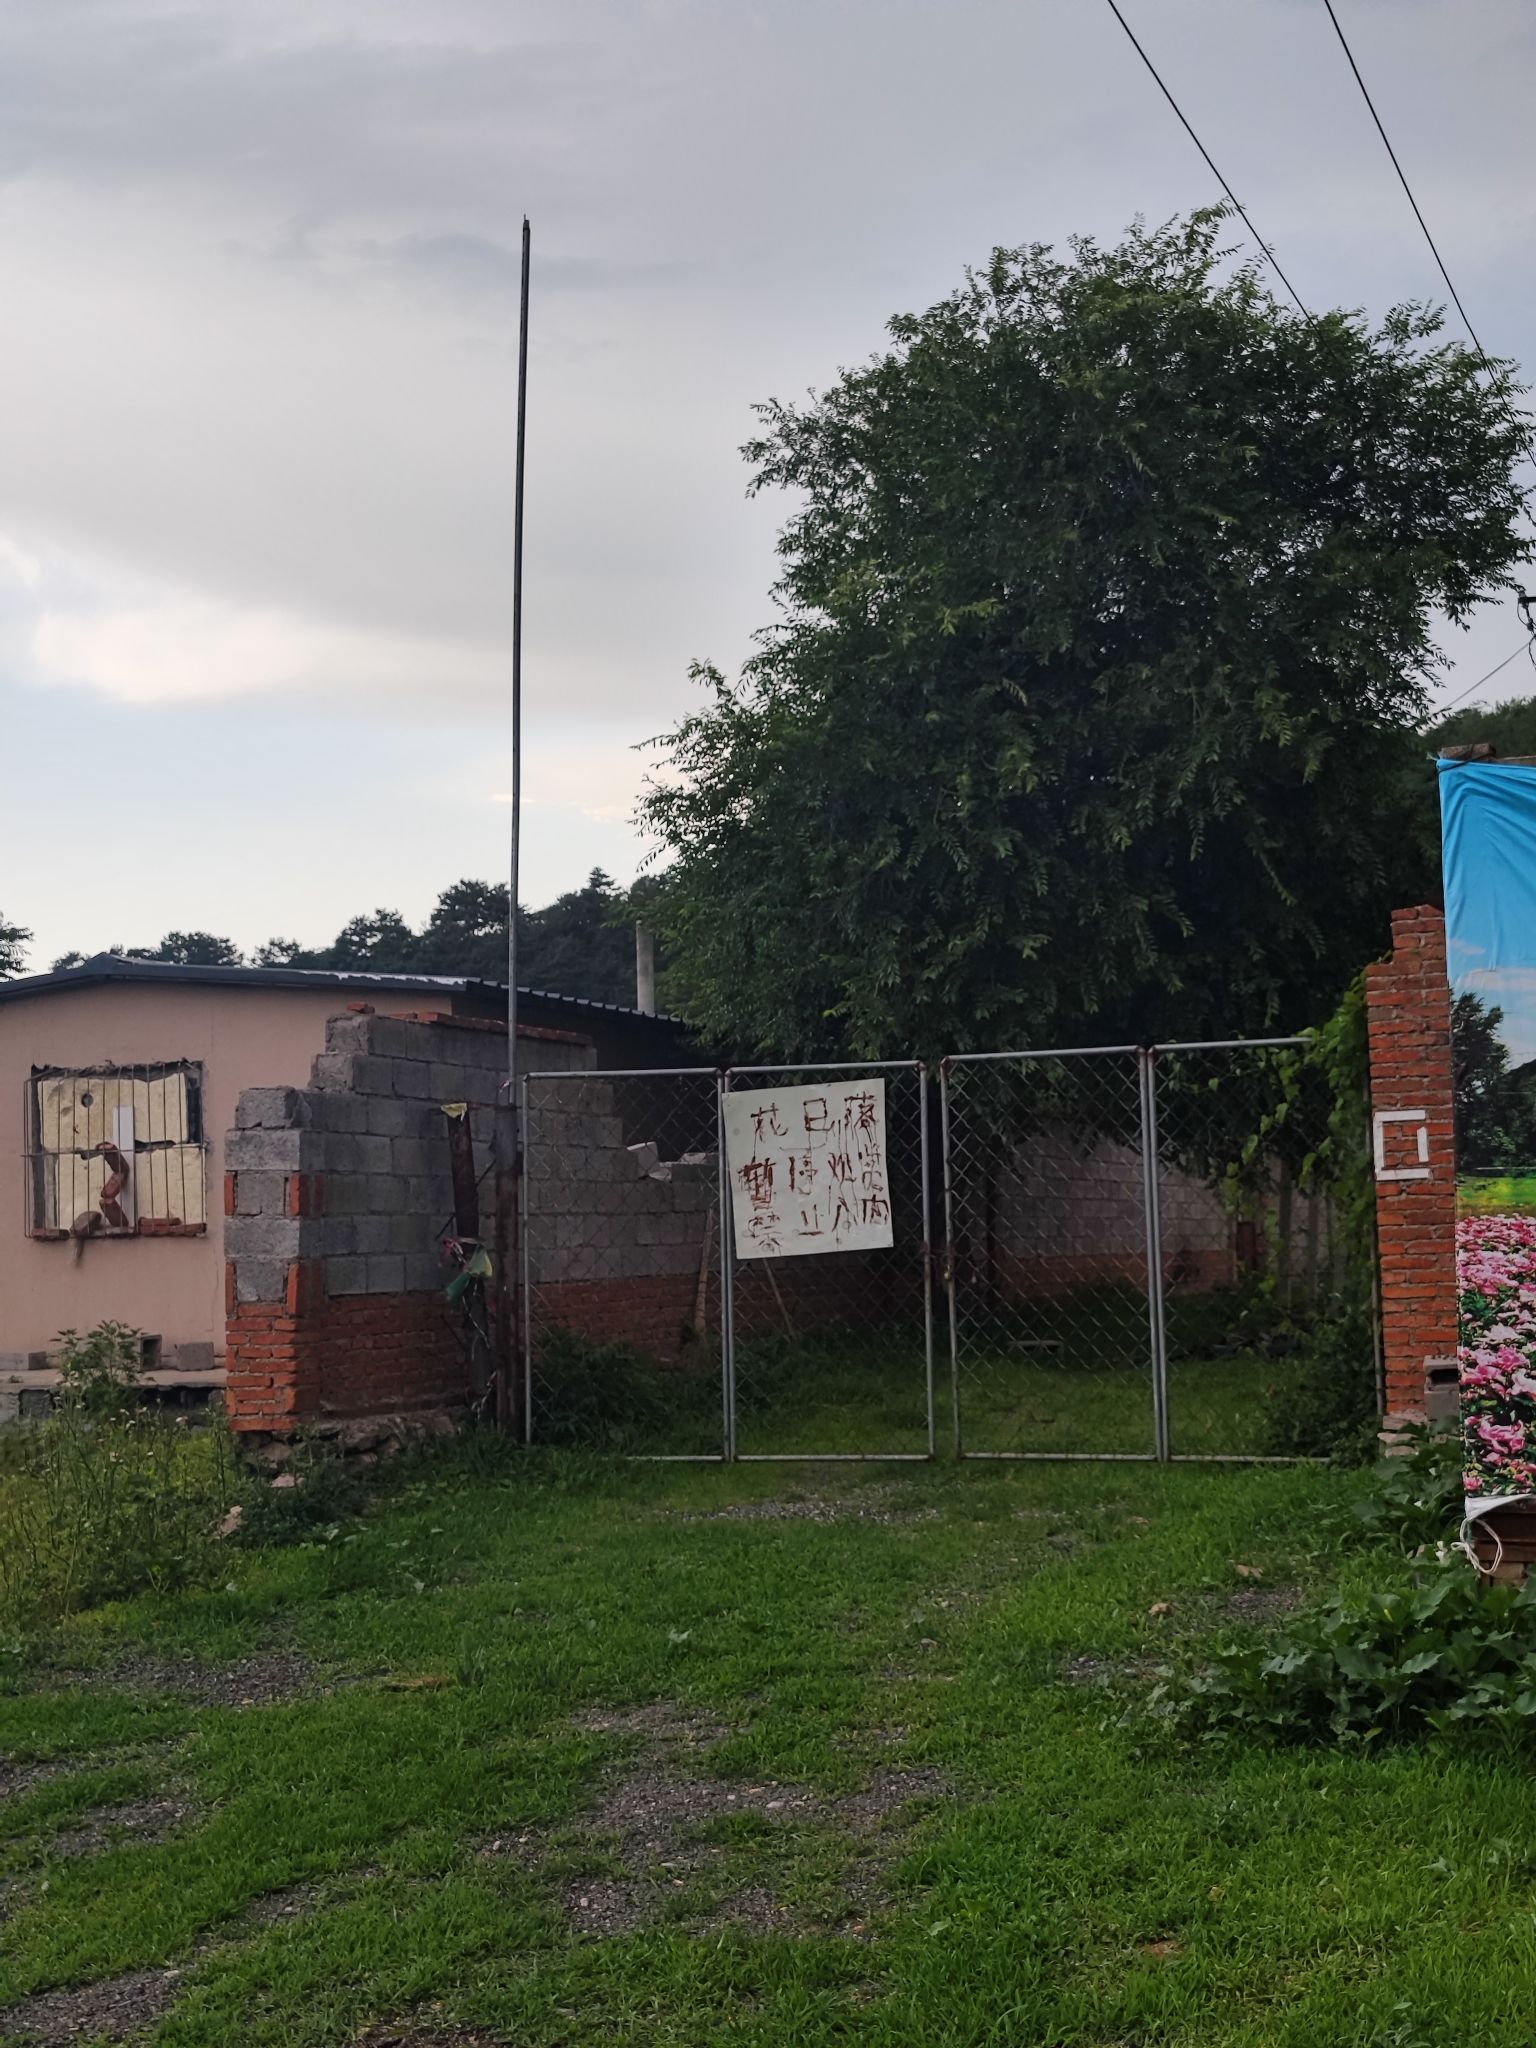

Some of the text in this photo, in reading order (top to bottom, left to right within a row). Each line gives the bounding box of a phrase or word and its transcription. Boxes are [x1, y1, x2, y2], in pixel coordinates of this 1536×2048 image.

[750, 1092, 878, 1140] 花已落
[747, 1195, 889, 1252] 禁止入内
